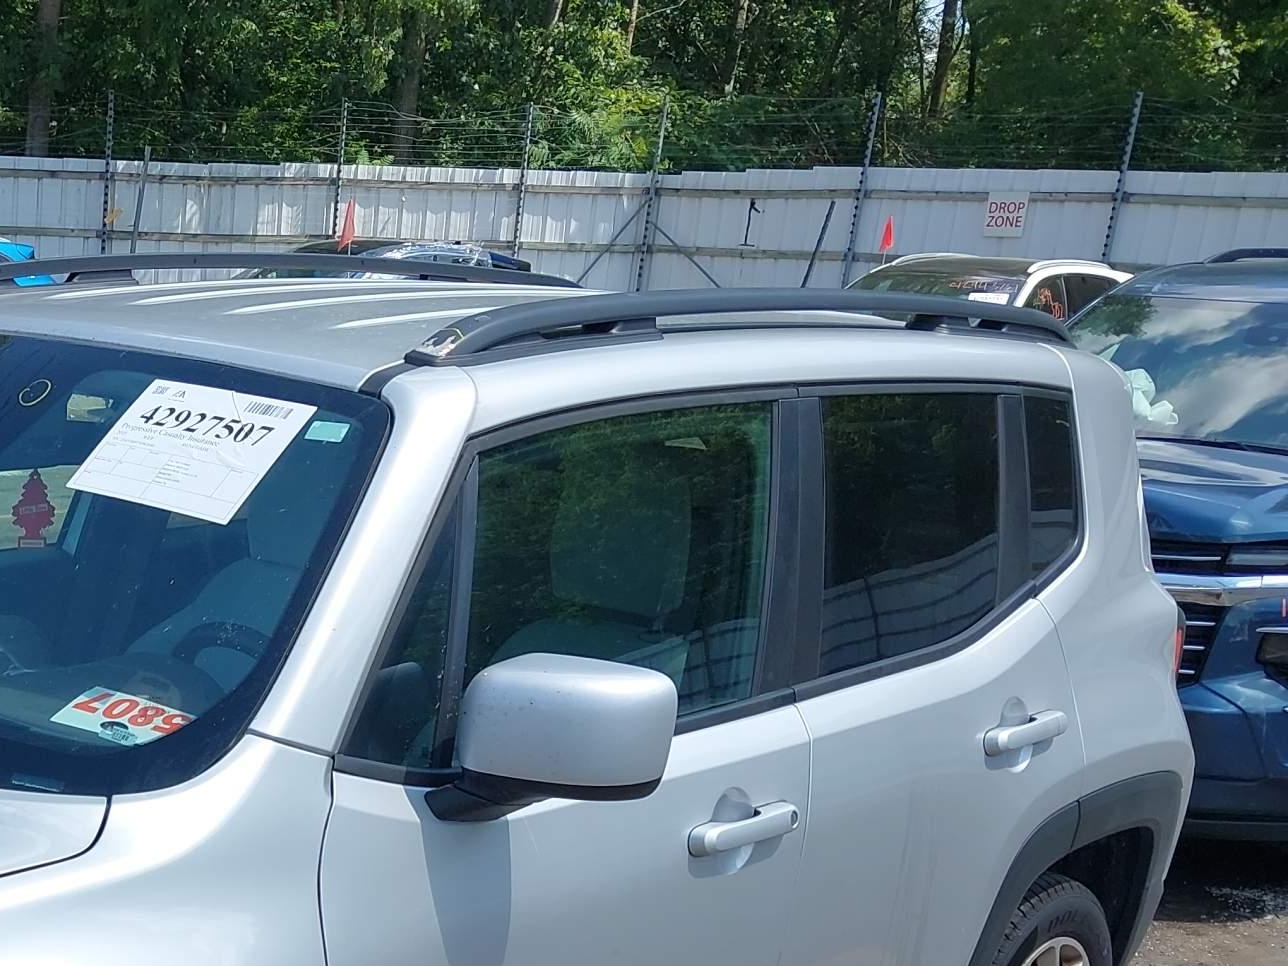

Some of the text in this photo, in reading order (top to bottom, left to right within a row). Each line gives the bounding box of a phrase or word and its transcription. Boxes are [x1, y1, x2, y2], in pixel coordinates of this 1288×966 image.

[988, 201, 1026, 214] DROP
[985, 215, 1023, 228] ZONE
[140, 405, 275, 446] 42927507
[72, 692, 193, 735] 5807
